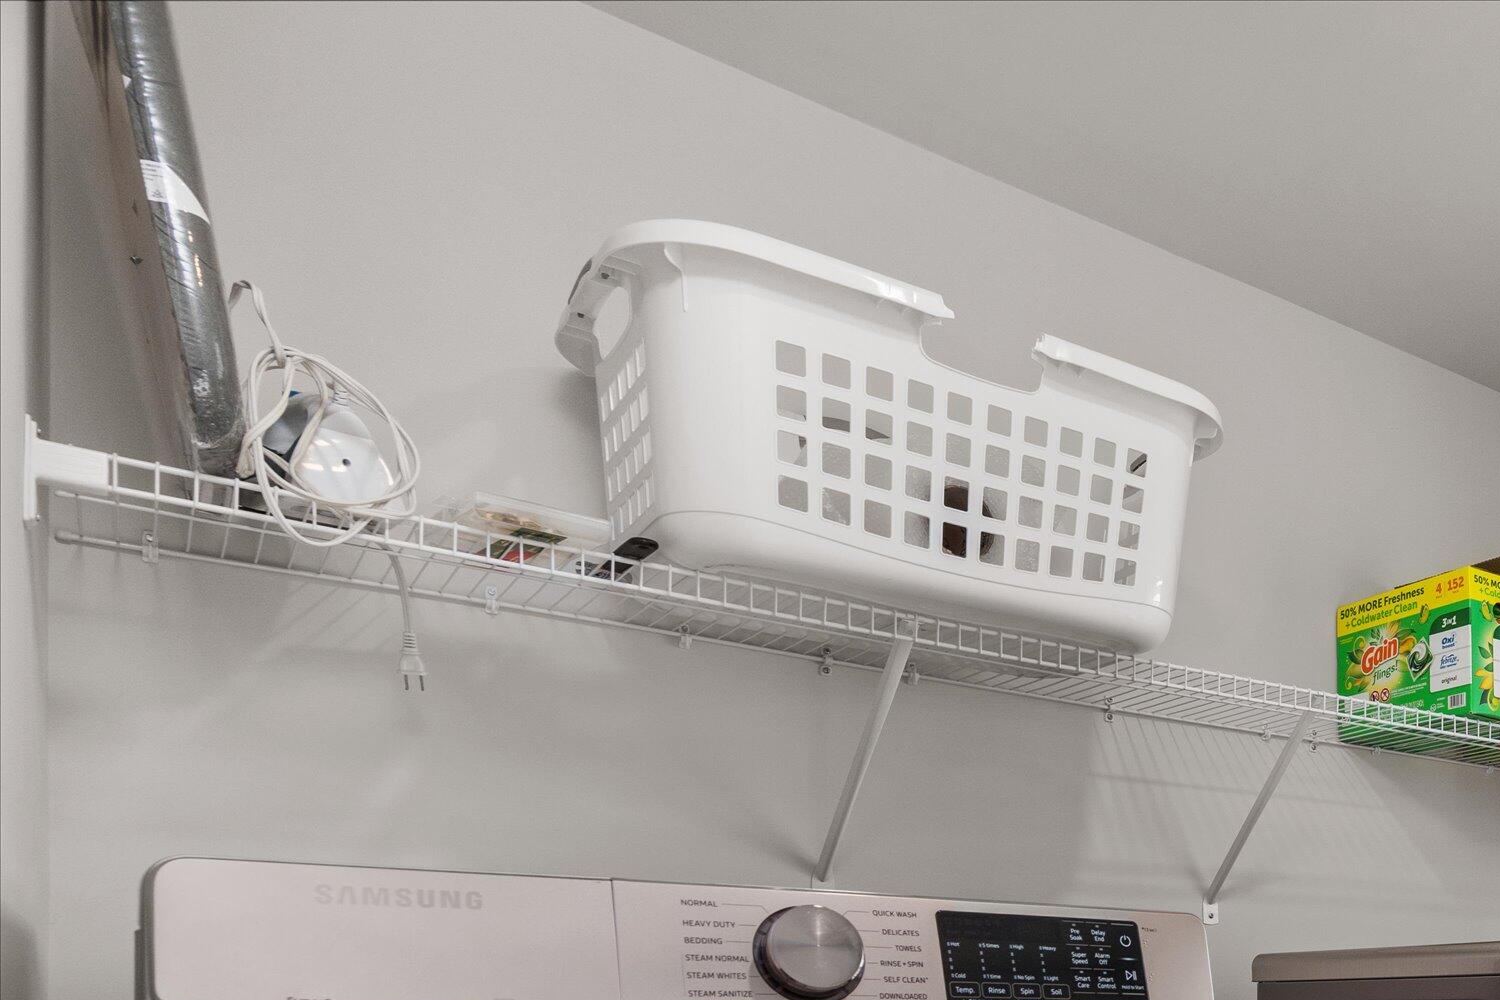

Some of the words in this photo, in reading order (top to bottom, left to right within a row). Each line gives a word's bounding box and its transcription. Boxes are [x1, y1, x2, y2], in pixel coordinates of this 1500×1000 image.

[1447, 576, 1464, 591] 152
[1473, 574, 1490, 587] 50%
[1435, 583, 1442, 594] 4
[1340, 607, 1357, 620] 50%
[1358, 598, 1383, 613] MORE
[1384, 586, 1425, 603] Freshness
[1350, 608, 1392, 627] Coldwater
[1393, 601, 1418, 615] Clean
[1441, 634, 1455, 645] Oxi
[1361, 637, 1399, 675] Gain
[1371, 660, 1398, 686] flings!
[313, 884, 484, 911] SAMSUNG
[680, 899, 718, 908] NORMAL
[872, 909, 895, 917] QUICK
[682, 919, 711, 928] HEAVY
[713, 920, 736, 928] DUTY
[881, 928, 920, 937] DELICATES
[1091, 929, 1106, 937] Delay
[683, 936, 723, 945] BEDDING
[894, 944, 922, 953] TOWELS
[684, 953, 713, 962] STEAM
[714, 955, 751, 963] NORMAL
[1071, 951, 1087, 959] Super
[880, 960, 902, 968] RINSE
[1071, 958, 1089, 966] Speed
[686, 971, 715, 980] STEAM
[716, 972, 747, 980] WHITES
[955, 986, 976, 994] Temp.
[1097, 982, 1117, 990] Control
[688, 989, 716, 998] STEAM
[717, 990, 754, 998] SANITIZE
[879, 992, 928, 1000] DOWNLOADED
[1020, 987, 1035, 996] Spin
